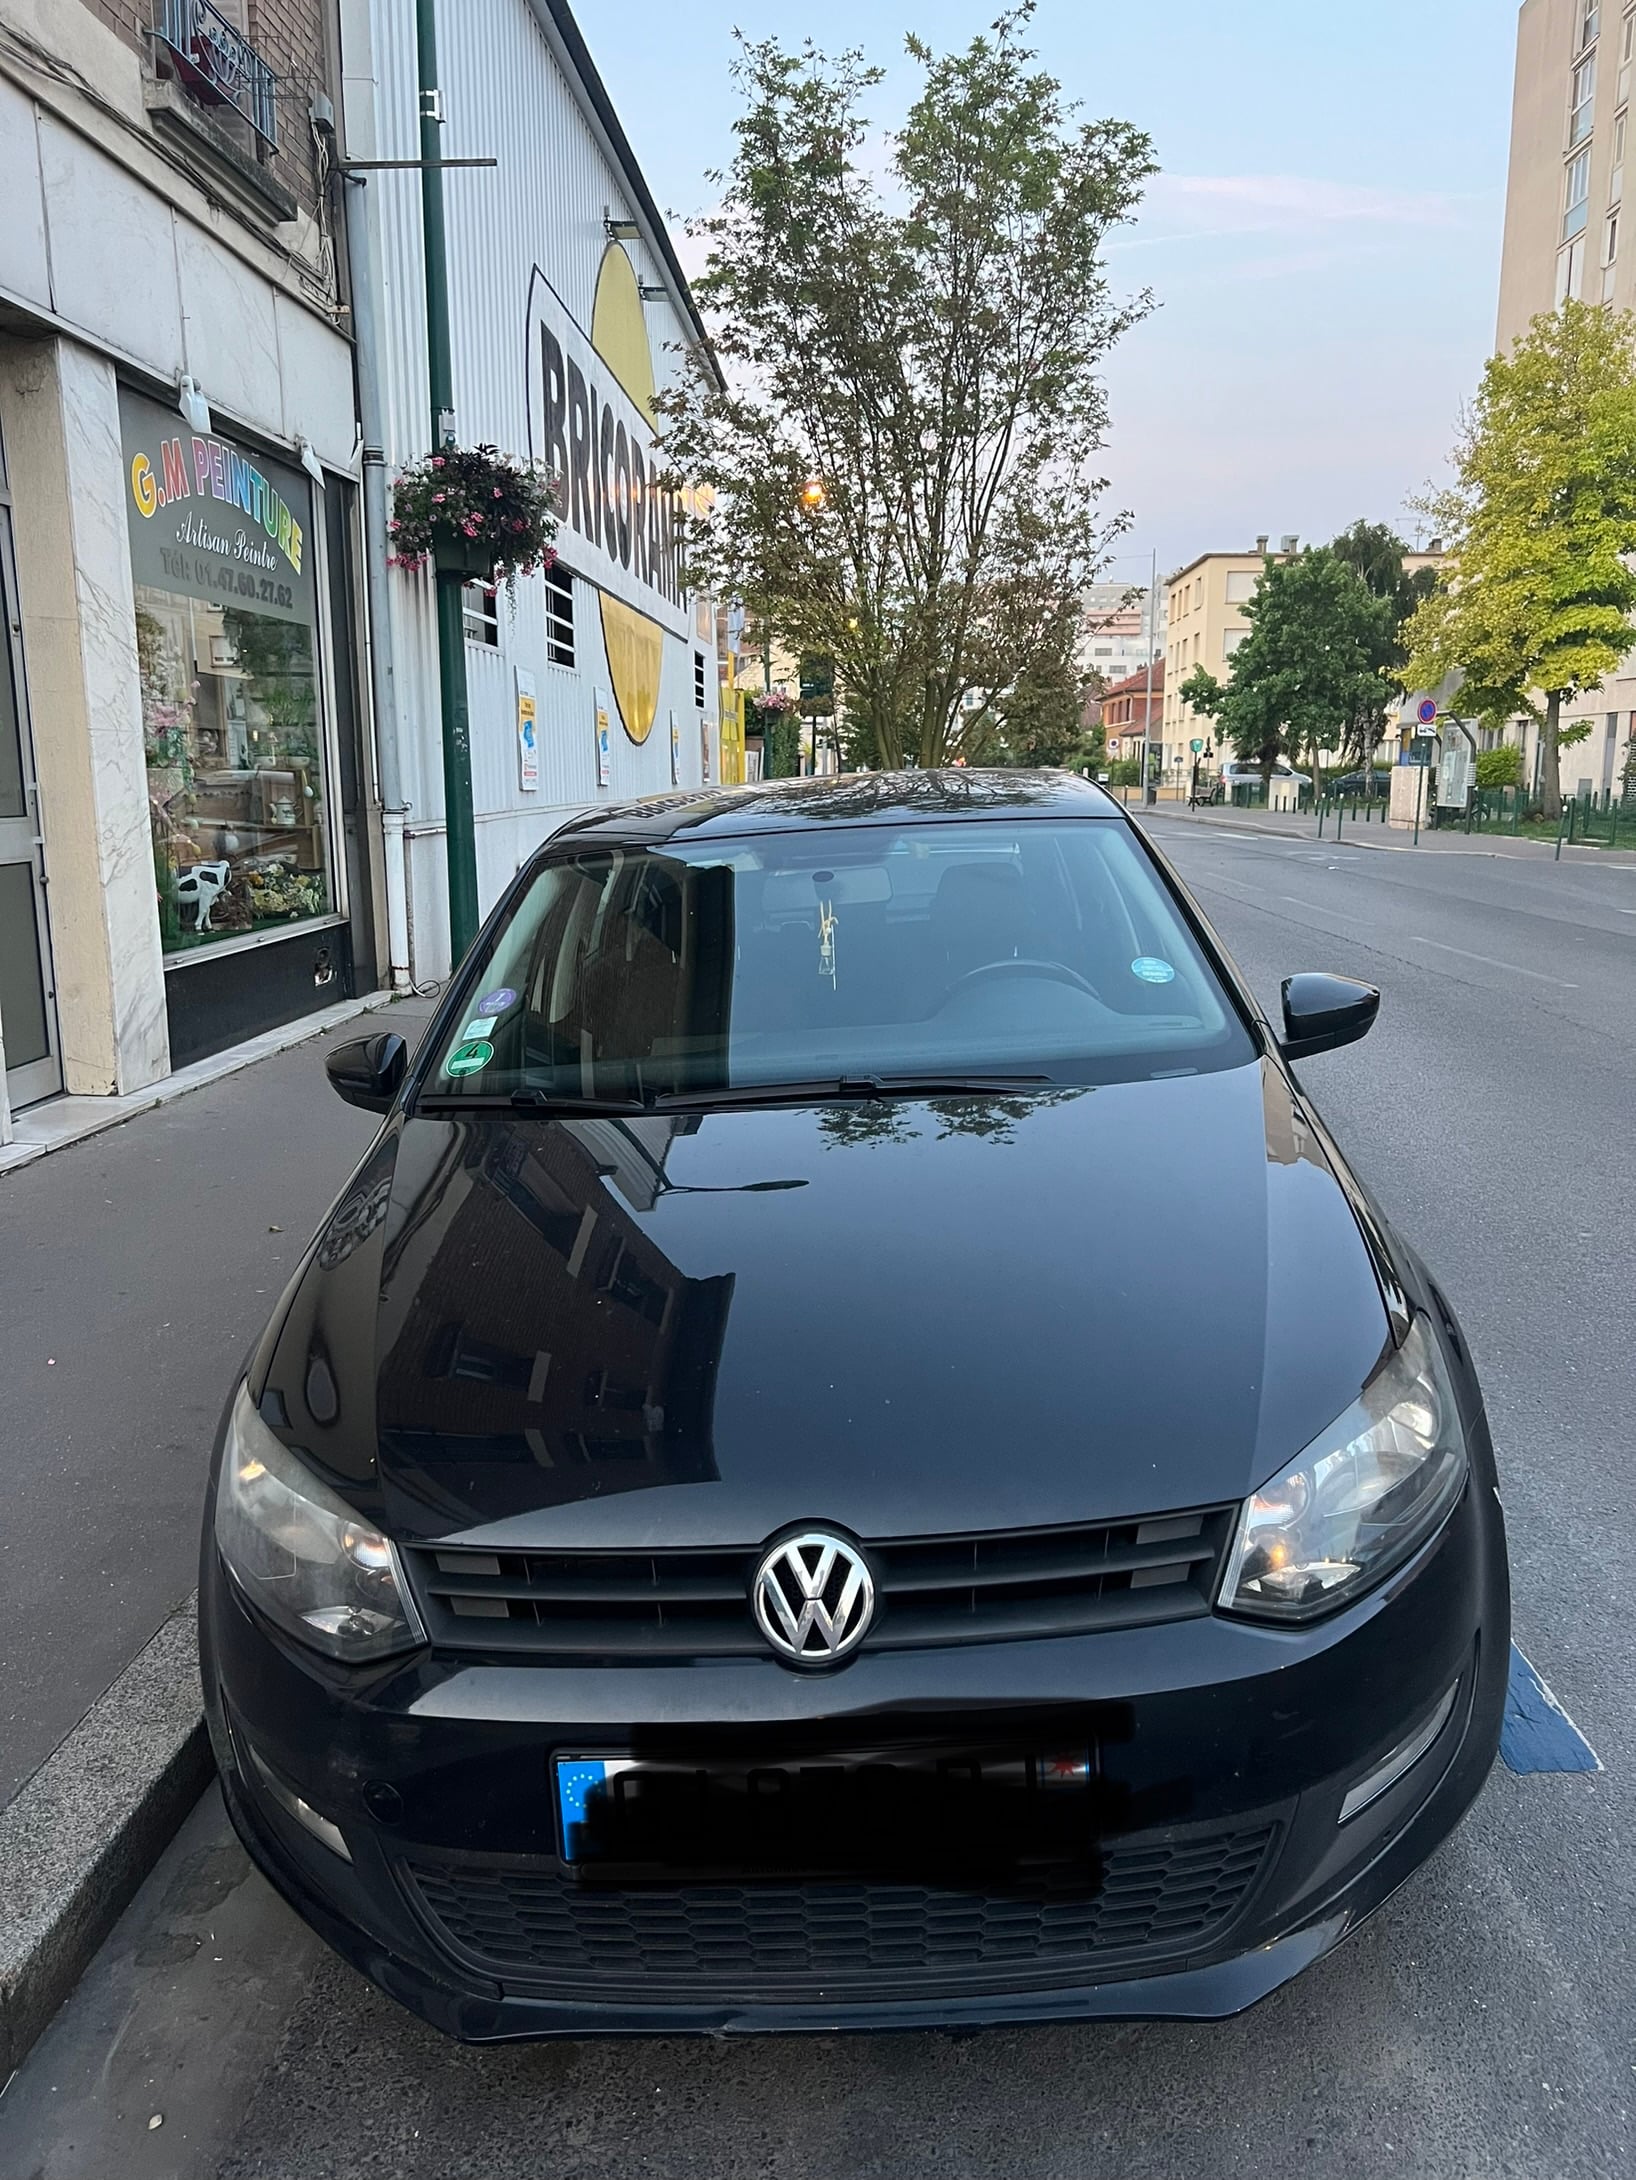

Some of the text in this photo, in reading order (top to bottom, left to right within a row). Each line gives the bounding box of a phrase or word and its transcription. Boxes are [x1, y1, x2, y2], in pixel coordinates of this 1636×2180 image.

[131, 437, 303, 577] G.M PEINTURE
[176, 511, 278, 571] Artisan Peintre
[465, 1043, 479, 1058] 4
[756, 1536, 872, 1661] VW
